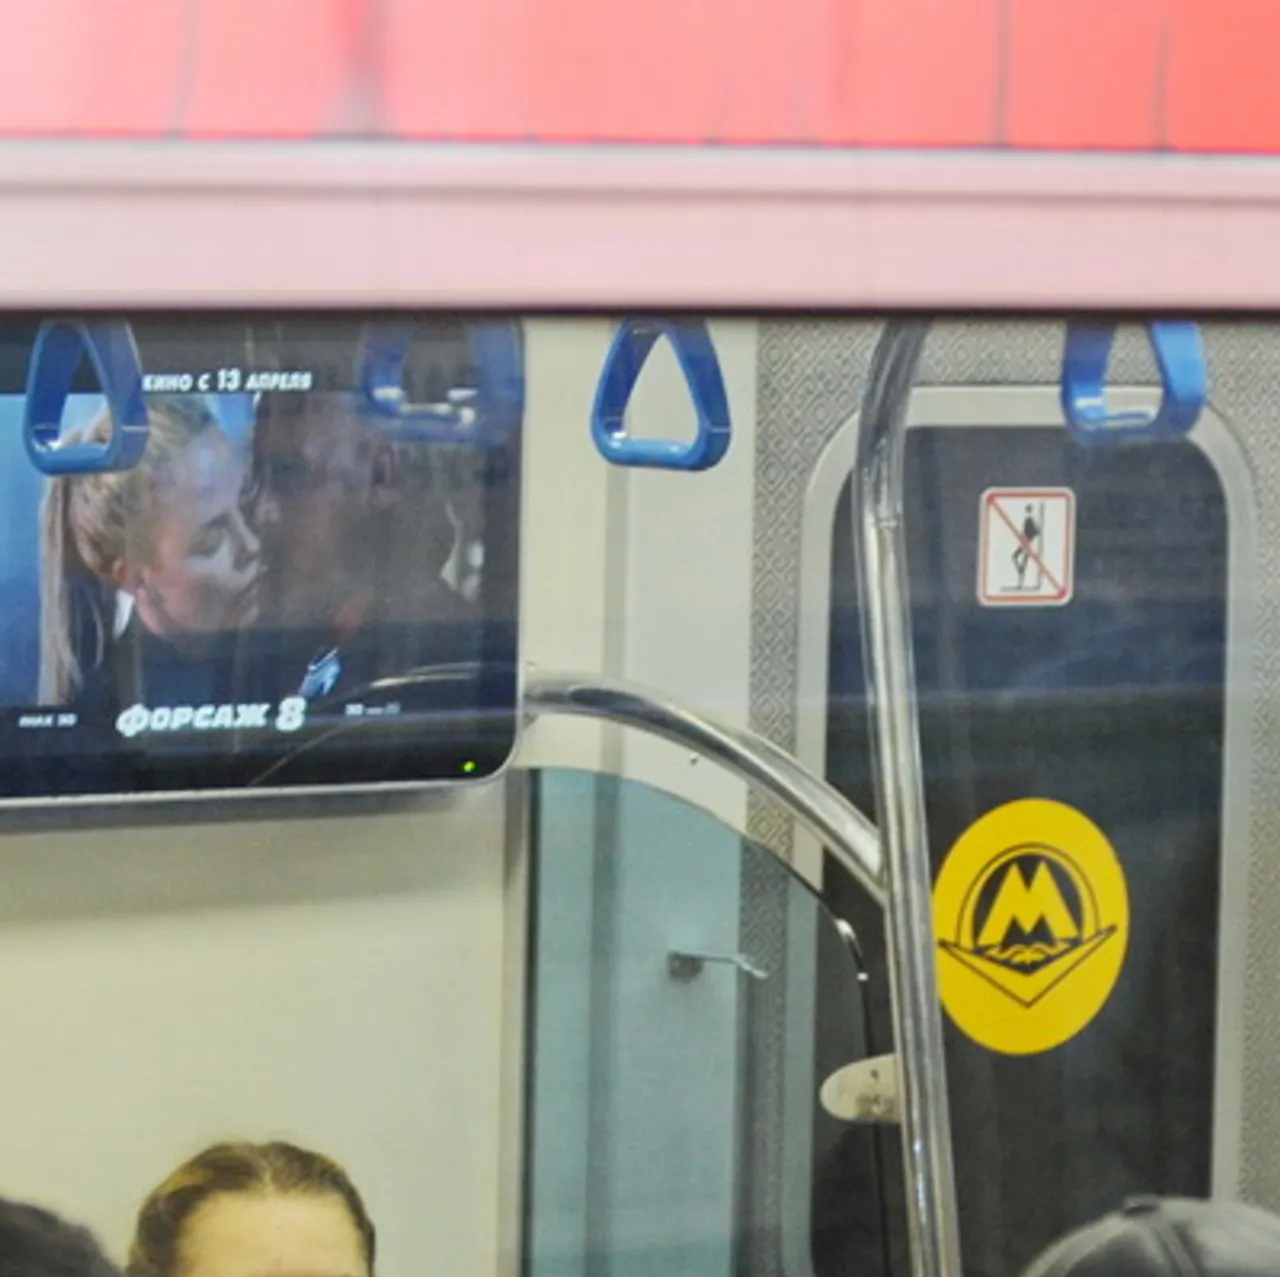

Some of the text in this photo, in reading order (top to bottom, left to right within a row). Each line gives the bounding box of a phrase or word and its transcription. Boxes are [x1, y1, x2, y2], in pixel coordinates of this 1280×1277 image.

[218, 368, 241, 391] 13
[246, 371, 312, 391] АПРЕЛЯ
[115, 703, 270, 737] ФОРСАЖ
[275, 697, 306, 731] 8
